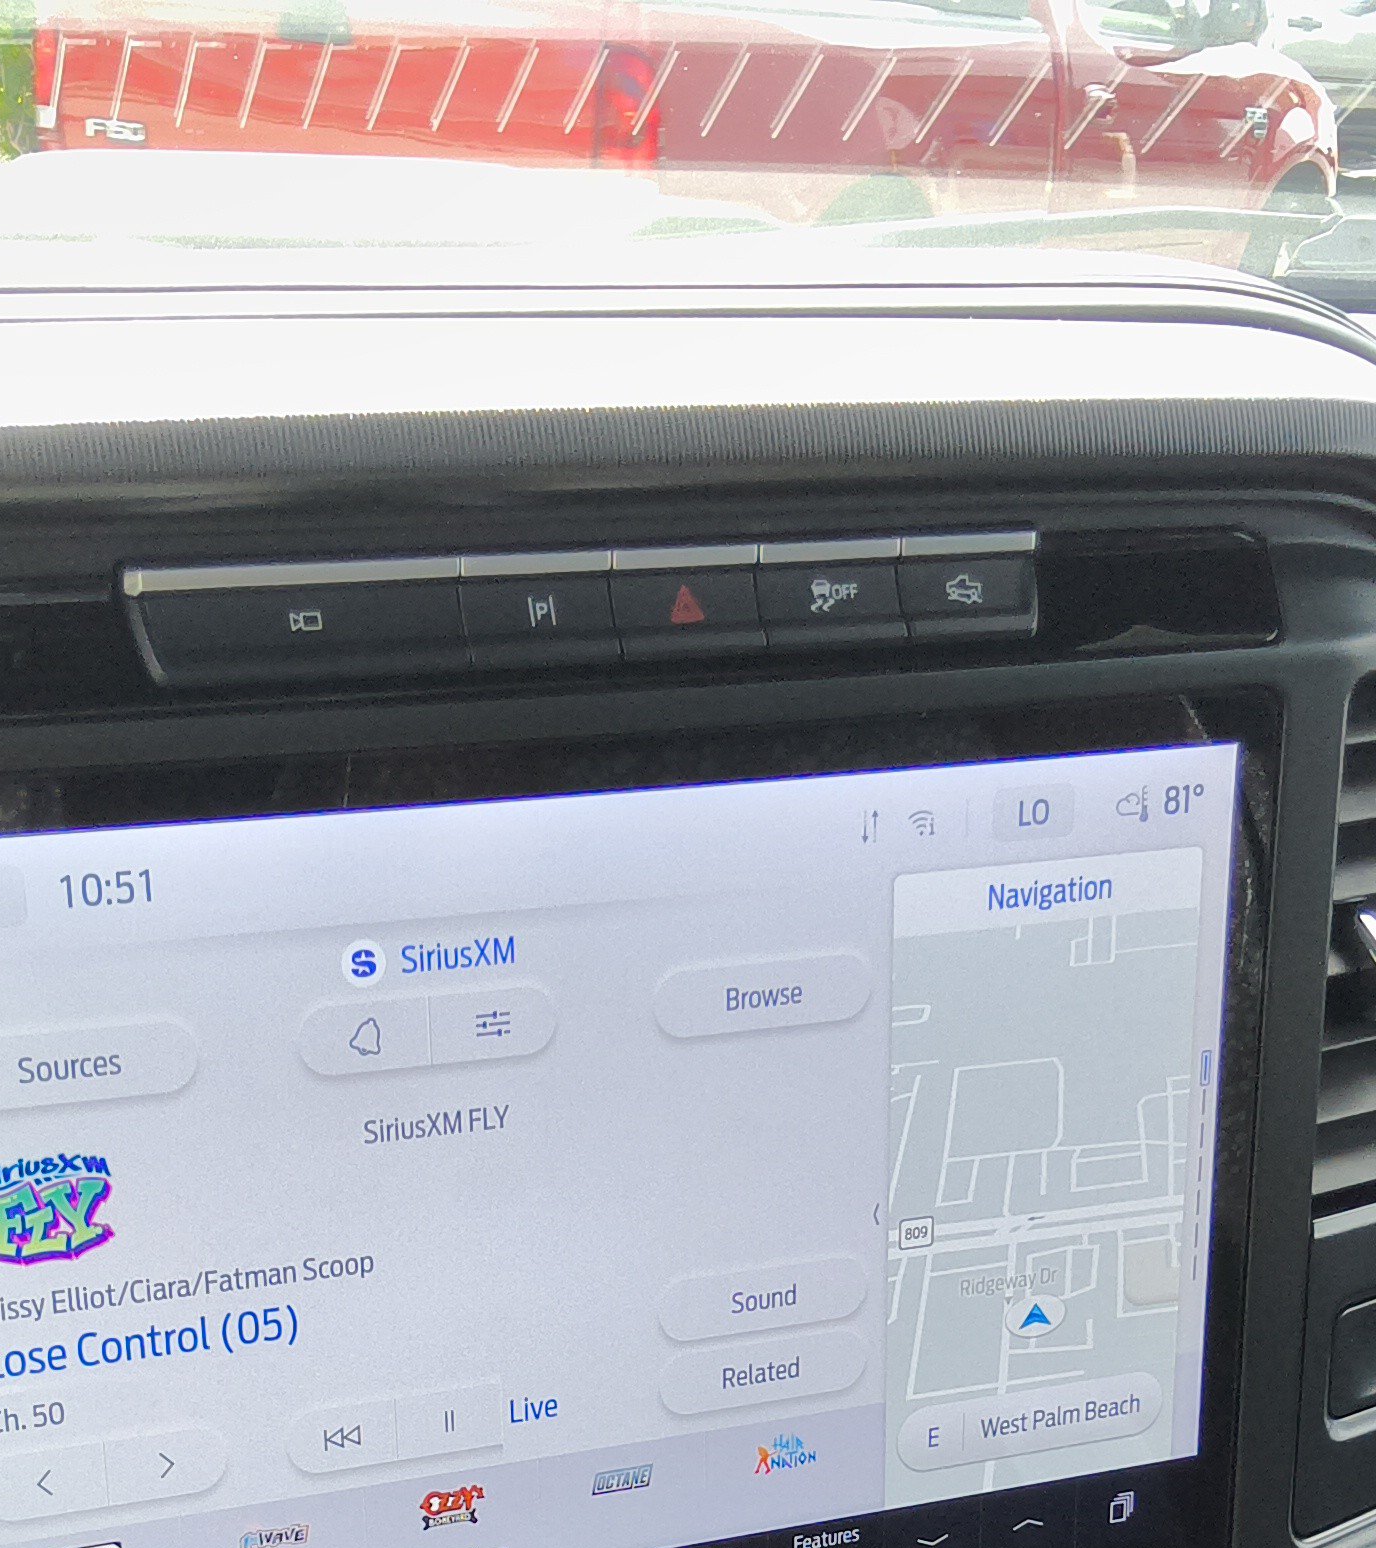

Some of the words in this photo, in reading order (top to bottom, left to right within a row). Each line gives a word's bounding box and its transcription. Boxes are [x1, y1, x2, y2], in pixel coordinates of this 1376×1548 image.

[831, 583, 858, 600] OFF
[1018, 798, 1050, 827] LO
[1163, 783, 1205, 816] 81°
[58, 867, 155, 910] 10:51
[987, 875, 1113, 911] Navigation
[401, 935, 516, 974] SiriusXM
[725, 983, 803, 1012] Browse
[18, 1053, 122, 1084] Sources
[363, 1110, 463, 1145] SiriusXM
[468, 1104, 511, 1135] FLY
[904, 1224, 928, 1242] 809
[51, 1261, 298, 1316] Elliot/Ciara/Fatman
[302, 1251, 376, 1282] Scoop
[959, 1271, 1036, 1297] Ridgeway
[1040, 1267, 1057, 1286] Dr
[730, 1284, 797, 1315] Sound
[76, 1317, 211, 1369] Control
[221, 1302, 300, 1354] (05)
[721, 1356, 801, 1390] Related
[32, 1401, 66, 1429] 50
[508, 1396, 559, 1425] Live
[927, 1426, 940, 1447] E
[980, 1413, 1029, 1439] West
[1033, 1404, 1081, 1432] Palm
[1084, 1393, 1141, 1424] Beach
[595, 1467, 649, 1491] OCTANE
